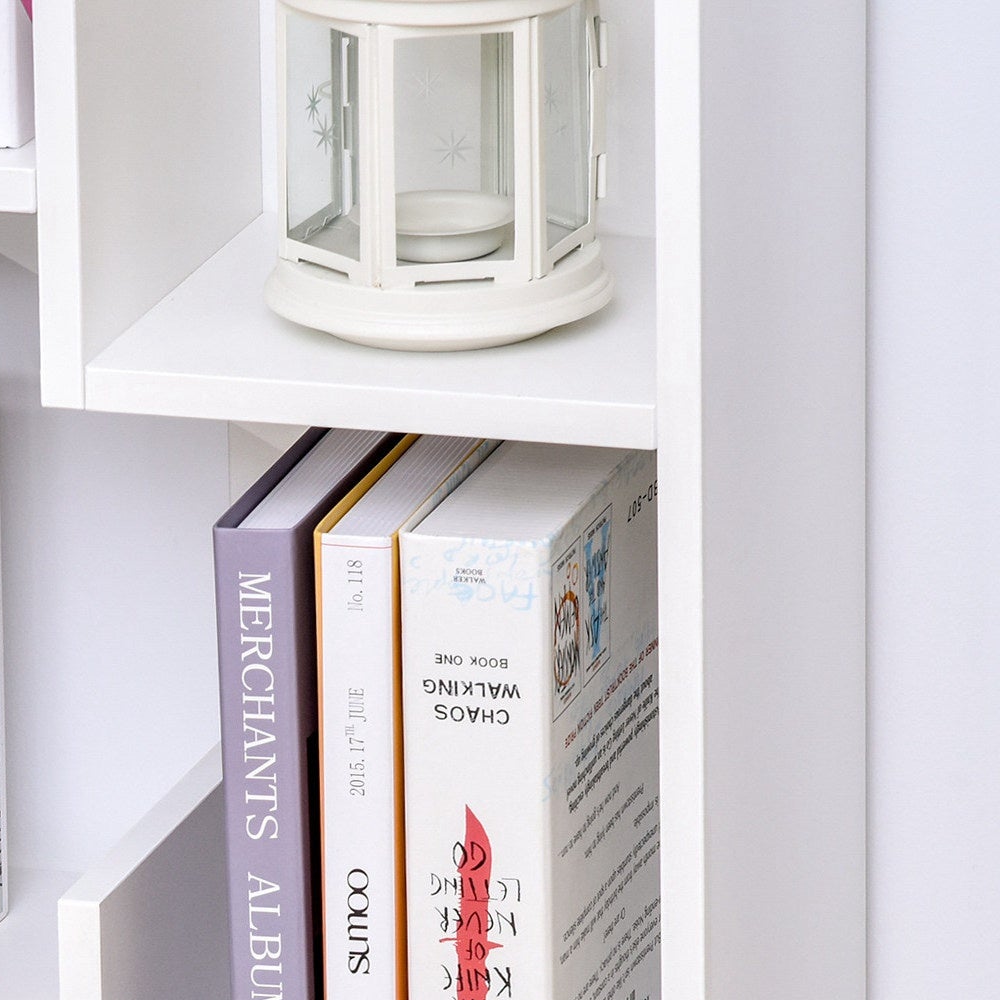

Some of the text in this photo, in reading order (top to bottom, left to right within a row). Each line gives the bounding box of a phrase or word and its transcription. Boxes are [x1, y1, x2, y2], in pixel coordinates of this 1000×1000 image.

[453, 576, 486, 584] WALKER
[455, 567, 483, 576] BOOKS
[434, 653, 509, 669] BOOK ONE
[422, 679, 521, 699] WALKING
[238, 570, 280, 840] MERCHANTS
[434, 704, 510, 725] CHAOS
[349, 758, 366, 797] 2015.
[452, 841, 487, 870] GO
[430, 873, 521, 902] LETTING
[434, 906, 517, 936] NEVER
[466, 939, 486, 961] OF
[441, 964, 512, 998] KNIFE
